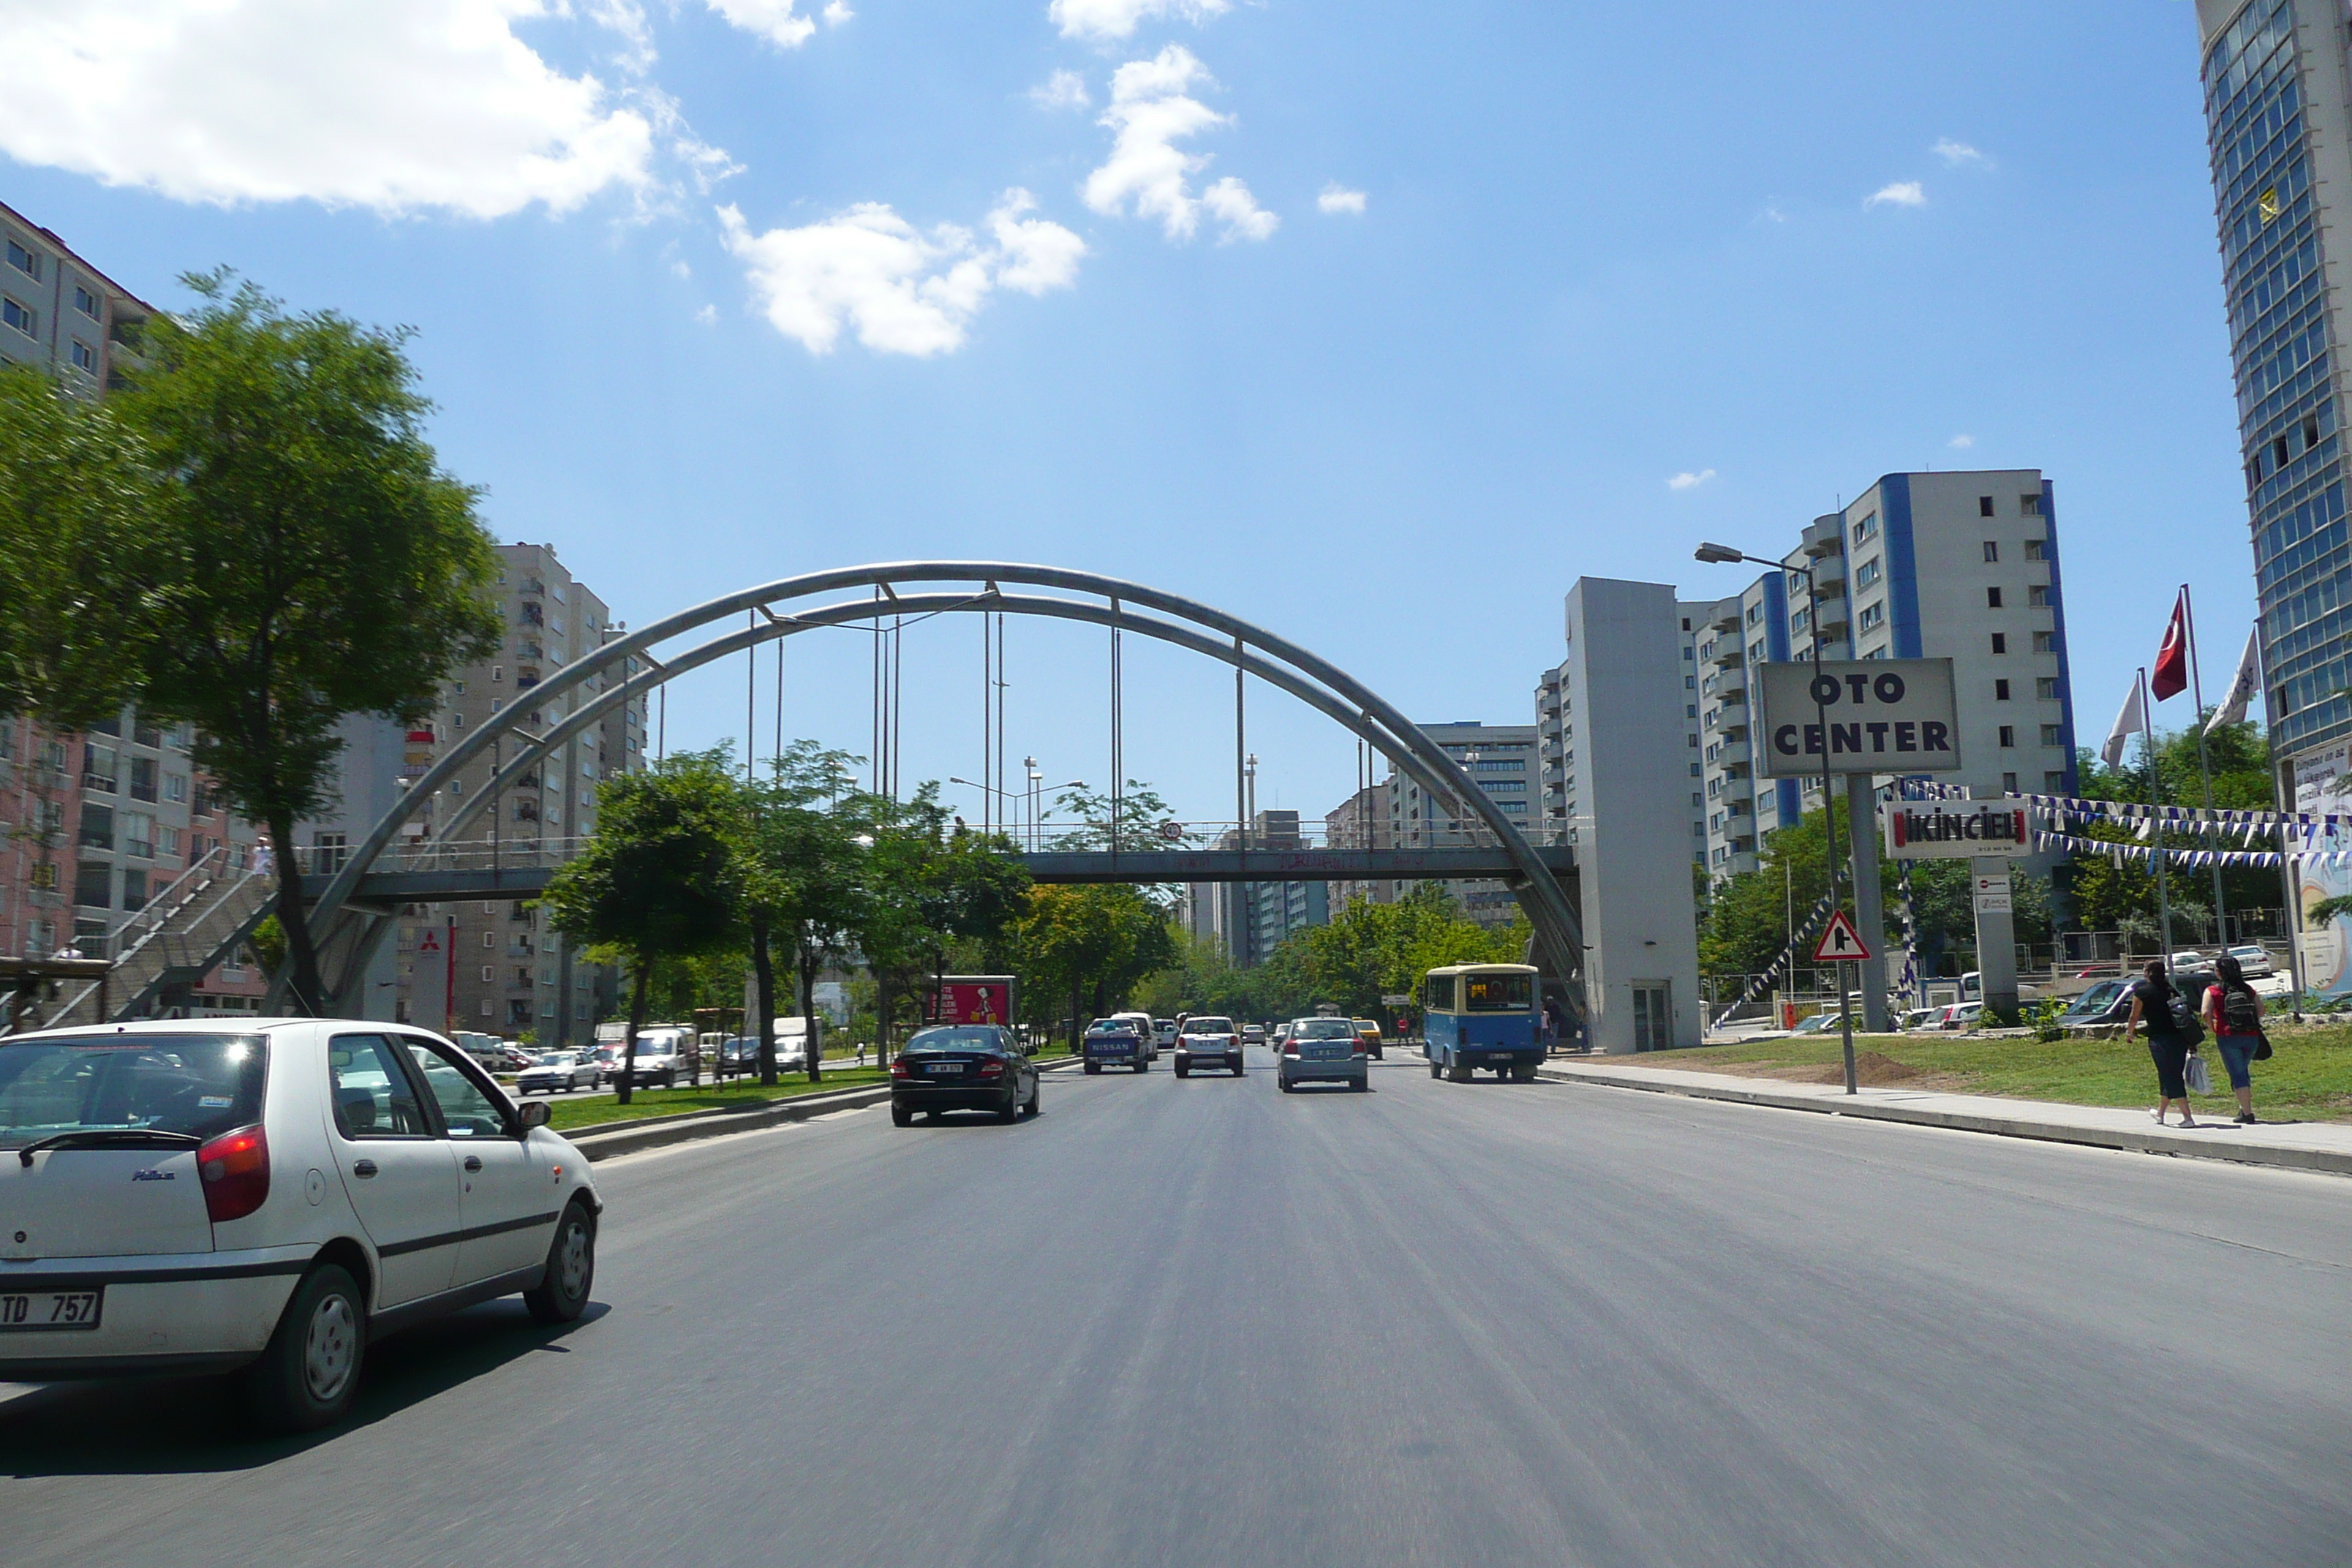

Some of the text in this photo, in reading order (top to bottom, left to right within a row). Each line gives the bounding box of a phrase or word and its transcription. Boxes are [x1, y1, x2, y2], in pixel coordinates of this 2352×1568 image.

[1810, 673, 1905, 706] OTO
[1774, 721, 1950, 755] CENTER
[1092, 1043, 1129, 1052] NISSAN
[2, 1294, 95, 1323] TD 757
